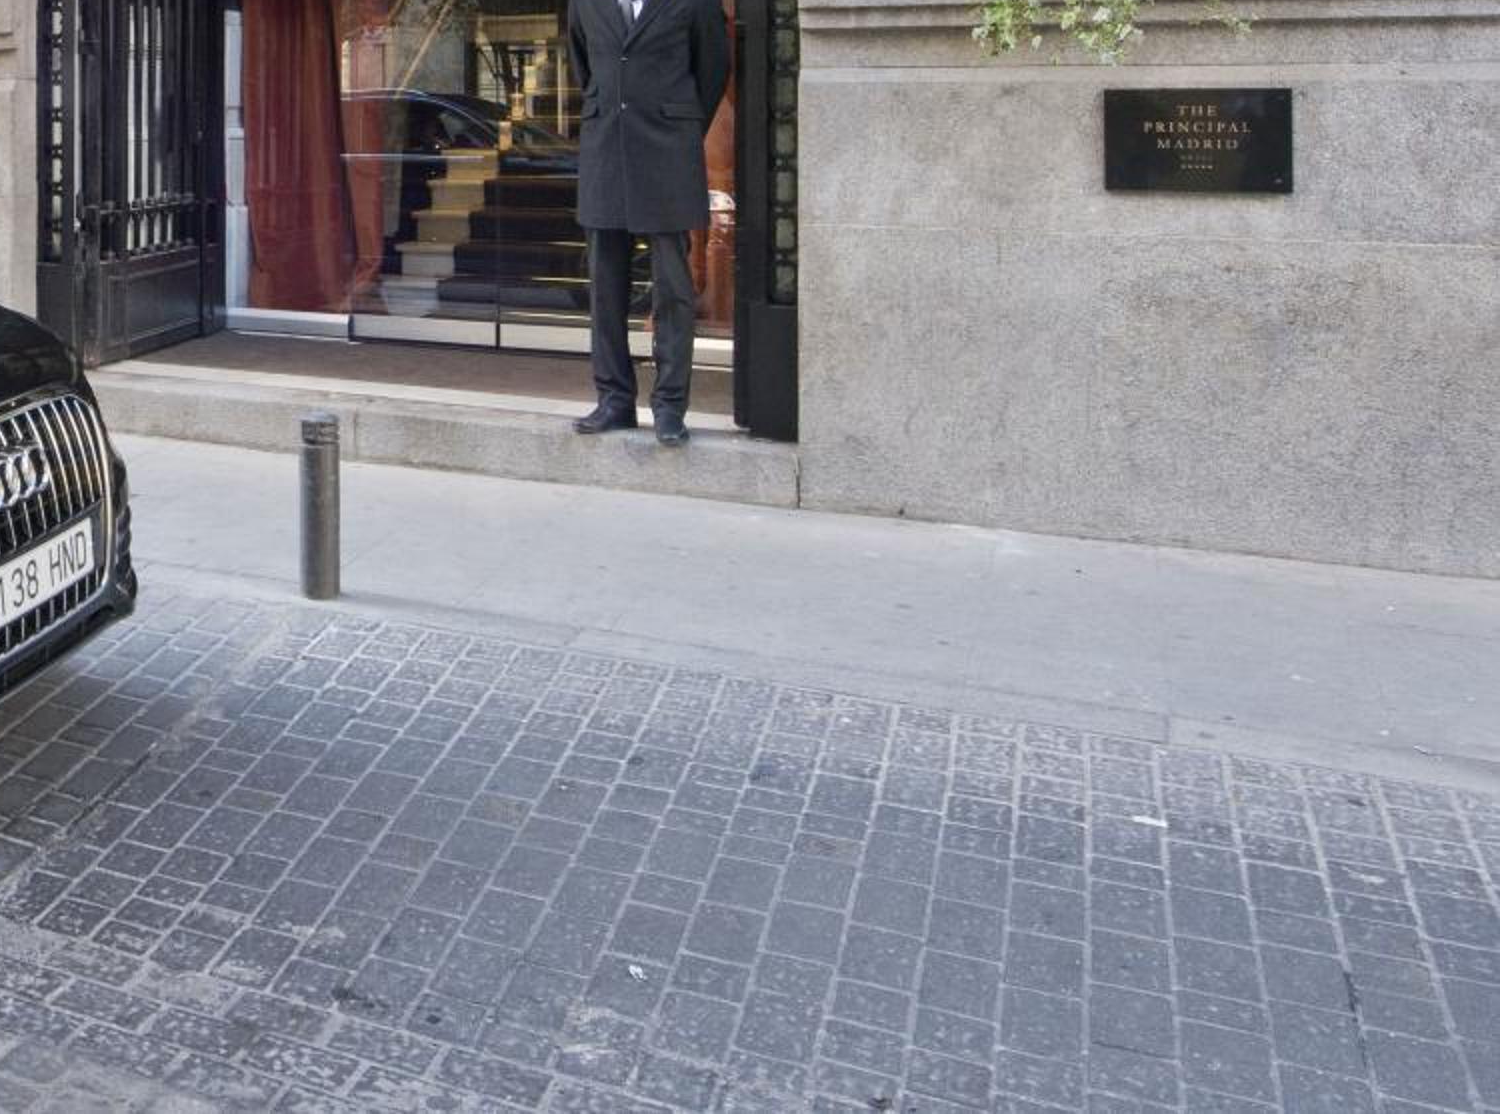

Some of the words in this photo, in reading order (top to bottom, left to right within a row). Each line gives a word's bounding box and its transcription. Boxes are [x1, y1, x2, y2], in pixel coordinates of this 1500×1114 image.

[1177, 105, 1218, 117] THE
[1143, 121, 1252, 133] PRINCIPAL
[1156, 138, 1239, 149] MADRID
[49, 531, 88, 587] HND
